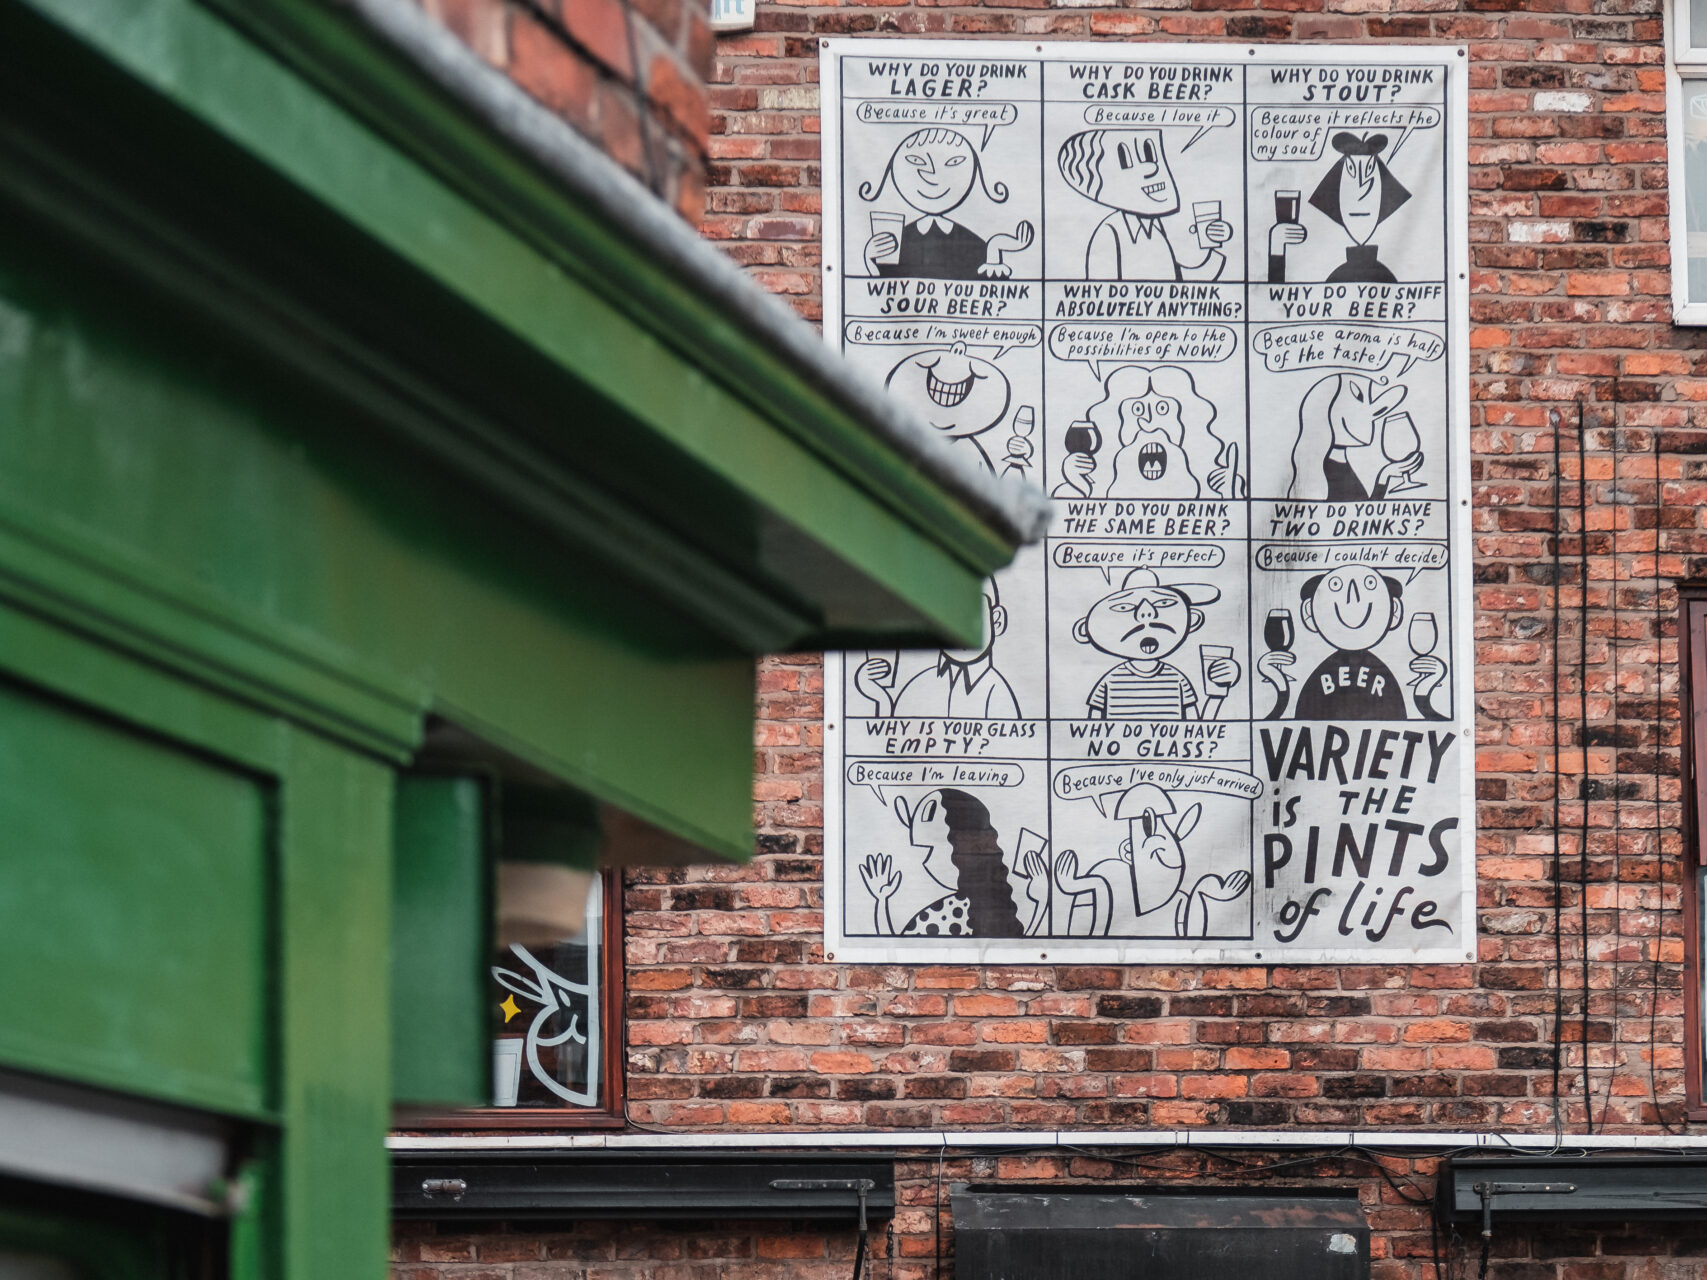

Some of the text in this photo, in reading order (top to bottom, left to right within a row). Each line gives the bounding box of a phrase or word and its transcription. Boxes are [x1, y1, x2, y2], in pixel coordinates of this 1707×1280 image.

[869, 62, 1027, 78] WHY DO YOU DRINK
[1070, 65, 1232, 82] WHY DO YOU DRINK
[1271, 68, 1433, 84] WHY DO YOU DRINK
[891, 78, 987, 98] LAGER?
[1083, 82, 1212, 100] CASK BEER?
[1303, 84, 1401, 102] STOUT?
[863, 104, 1008, 122] Because it's great
[1095, 108, 1220, 122] Because I love it
[1262, 110, 1432, 125] Because it reflects the
[1254, 125, 1322, 142] colour of
[1257, 141, 1316, 160] my soul
[867, 280, 1029, 299] WHY DO YOU DRINK
[1064, 284, 1220, 300] WHY DO YOU DRINK
[1270, 285, 1441, 301] WHY DO YOU SNIFF
[880, 297, 1007, 316] SOUR BEER?
[1056, 300, 1242, 318] ABSOLUTELY ANYTHING?
[1283, 301, 1416, 318] YOUR BEER?
[855, 325, 1036, 344] Because I'm sweet enough
[1058, 327, 1226, 344] Because I'm open to the
[1068, 342, 1221, 359] possibilities of NOW!
[1264, 330, 1440, 358] Because aroma is half
[1274, 343, 1386, 369] of the taste!
[1068, 503, 1228, 517] WHY DO YOU DRINK
[1275, 502, 1431, 519] WHY DO YOU HAVE
[1064, 518, 1230, 536] THE SAME BEER?
[1270, 518, 1424, 538] TWO DRINKS?
[1063, 546, 1217, 565] Because it's perfect
[1264, 547, 1445, 563] Because I couldn't decide!
[1321, 666, 1386, 697] BEER
[866, 720, 1036, 738] WHY IS YOUR GLASS
[1070, 723, 1226, 739] WHY DO YOU HAVE
[886, 737, 989, 754] EMPTY?
[1088, 739, 1218, 758] NO GLASS?
[1260, 725, 1456, 785] VARIETY
[857, 764, 1011, 786] Because I'm leaving
[1063, 768, 1258, 794] Because I've only just arrived
[1273, 785, 1417, 828] is THE
[1264, 817, 1459, 888] PINTS
[1273, 881, 1453, 943] of life
